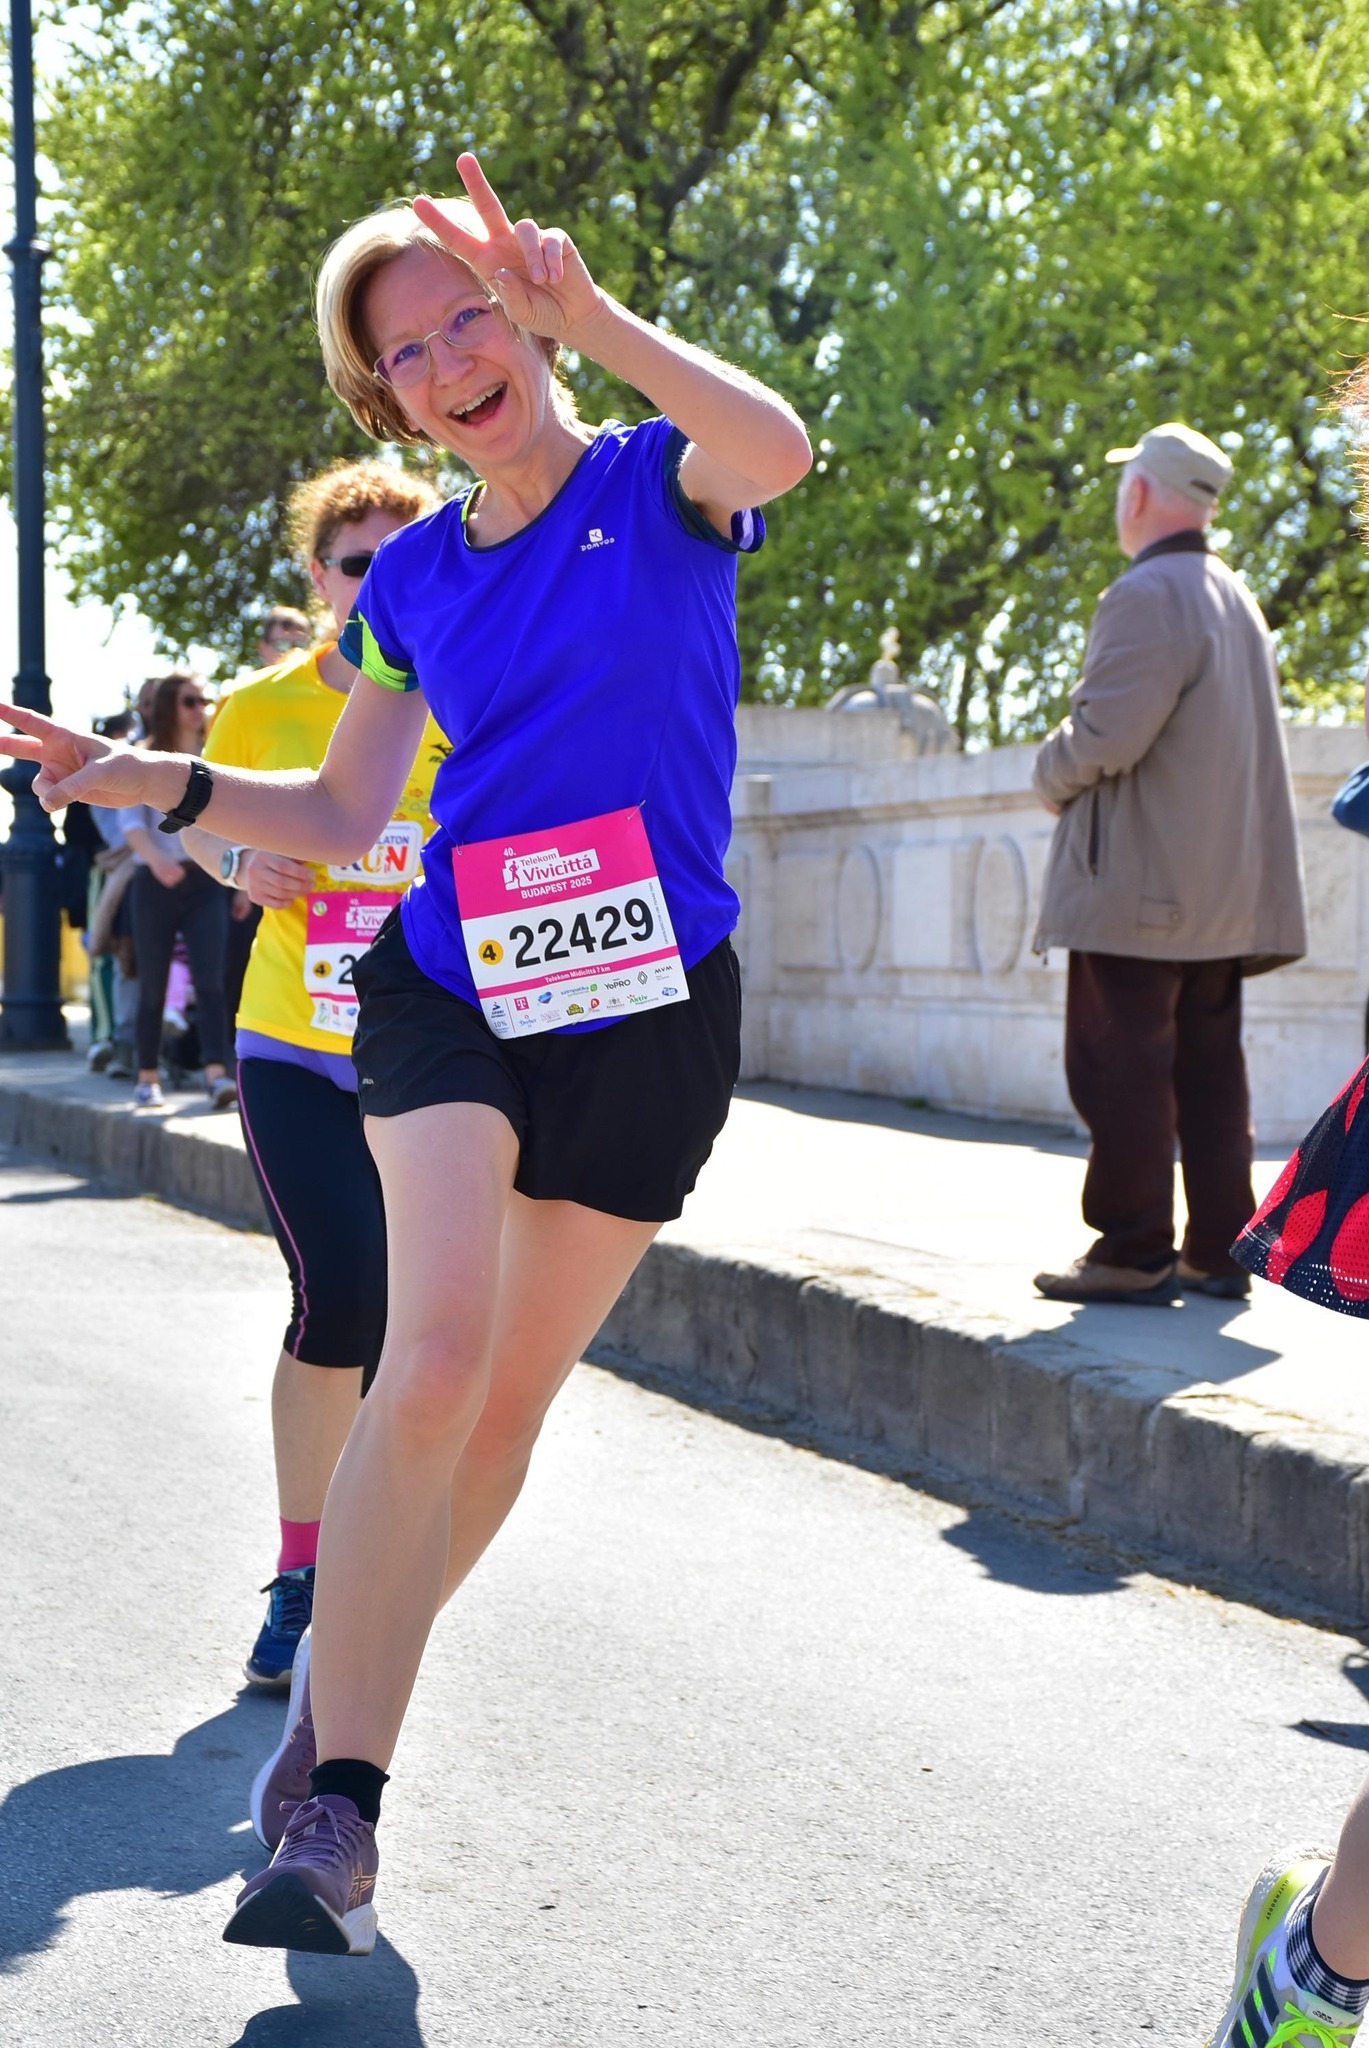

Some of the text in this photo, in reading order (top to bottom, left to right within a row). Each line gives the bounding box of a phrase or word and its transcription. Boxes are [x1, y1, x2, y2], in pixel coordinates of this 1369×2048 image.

[503, 847, 516, 857] 40.
[520, 852, 557, 867] Telekom
[523, 854, 593, 882] Vivicittá
[520, 875, 592, 899] BUDAPEST 2025
[483, 944, 497, 961] 4
[509, 898, 655, 969] 22429
[314, 953, 357, 985] 4 2
[545, 974, 571, 984] Telekom
[596, 966, 601, 974] 7
[601, 965, 612, 973] km
[654, 965, 673, 974] MVM
[604, 979, 631, 990] YoPRO
[493, 1020, 508, 1028] 10%
